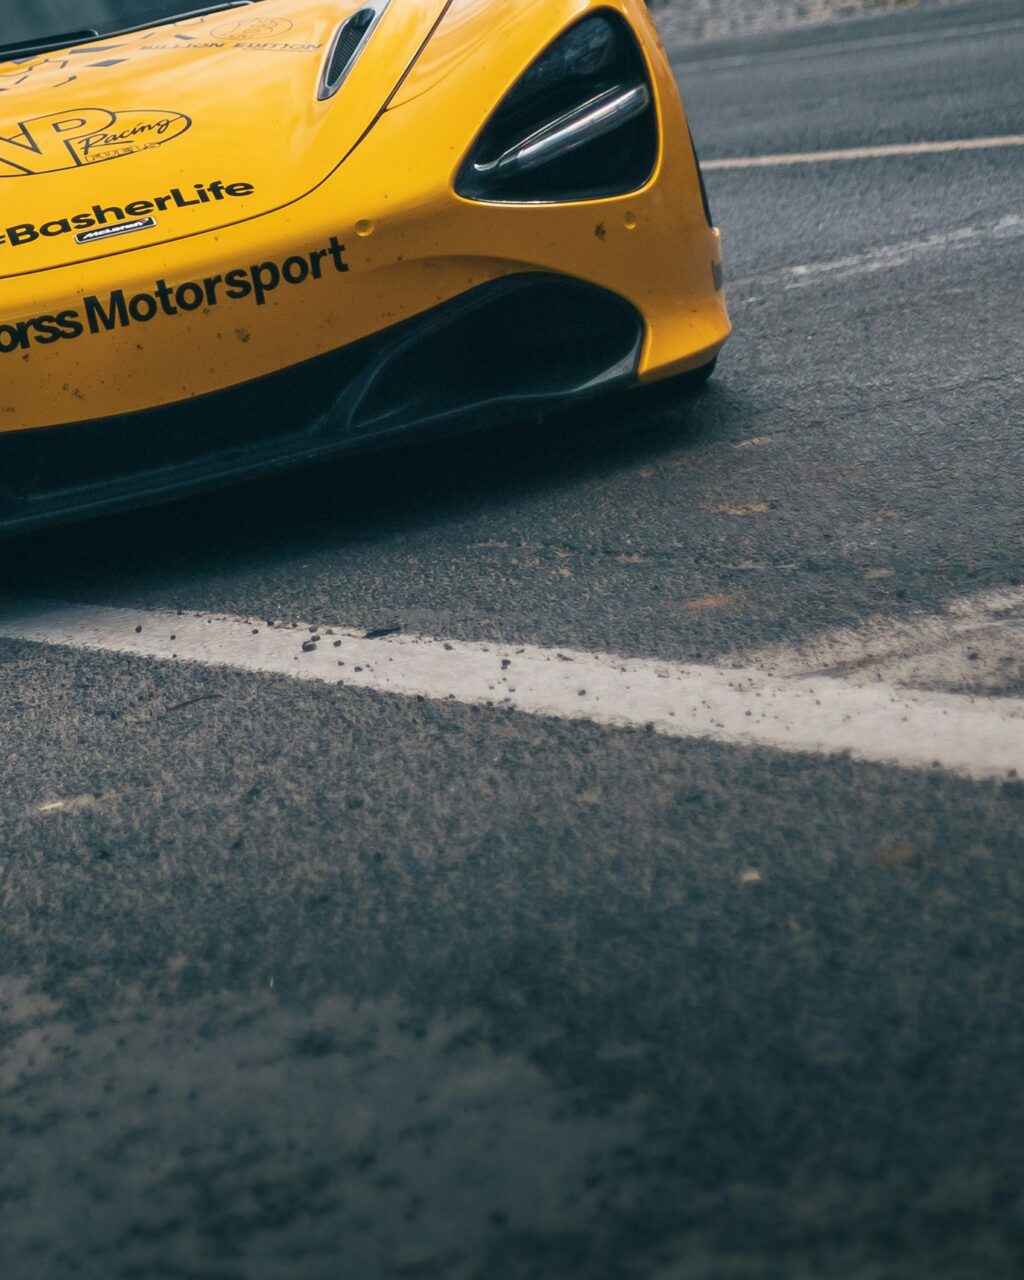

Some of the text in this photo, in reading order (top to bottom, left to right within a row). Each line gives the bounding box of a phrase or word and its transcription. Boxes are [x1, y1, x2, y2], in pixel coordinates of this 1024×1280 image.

[140, 41, 323, 52] BILLION EDITION
[77, 115, 185, 155] Racing
[82, 236, 350, 333] Motorsport
